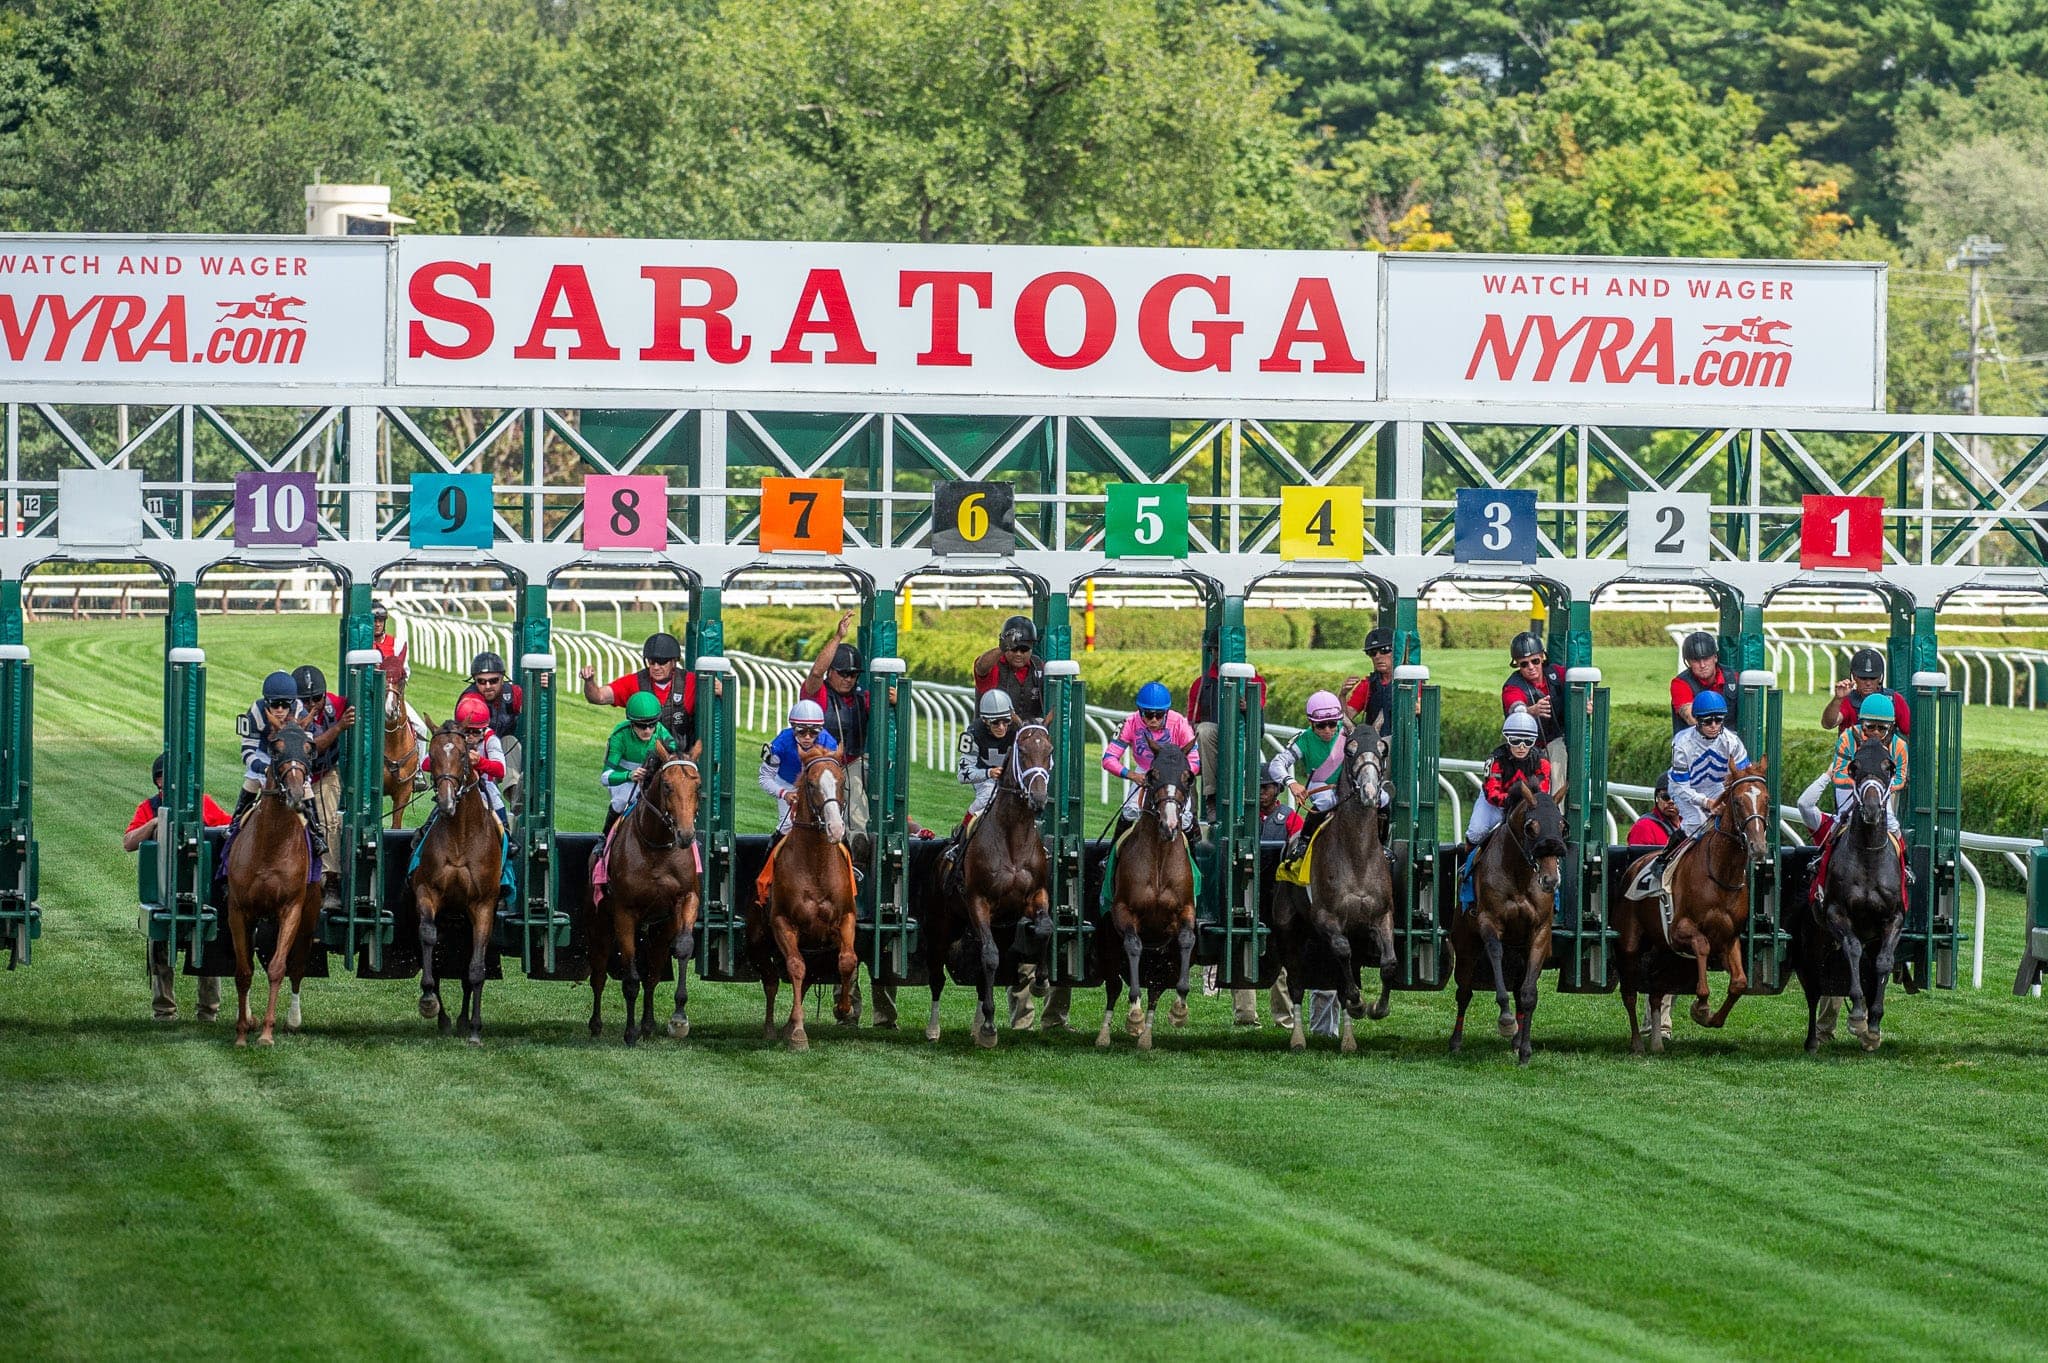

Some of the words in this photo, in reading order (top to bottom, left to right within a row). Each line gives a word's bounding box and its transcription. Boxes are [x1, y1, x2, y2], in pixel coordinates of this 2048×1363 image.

[0, 255, 99, 274] WATCH
[118, 256, 182, 275] AND
[200, 256, 307, 276] WAGER
[1483, 275, 1589, 296] WATCH
[1606, 278, 1670, 297] AND
[1688, 280, 1793, 300] WAGER
[0, 294, 307, 364] NYRA.com
[408, 260, 1366, 375] SARATOGA
[1465, 314, 1793, 388] NYRA.com
[25, 498, 39, 511] 12
[149, 500, 162, 514] 11
[249, 484, 305, 533] 10
[437, 486, 468, 533] 9
[610, 488, 640, 536] 8
[788, 491, 818, 539] 7
[957, 493, 989, 542] 6
[1135, 496, 1164, 545] 5
[1305, 499, 1336, 546] 4
[1482, 502, 1512, 551] 3
[1655, 506, 1685, 554] 2
[1830, 507, 1851, 557] 1
[237, 716, 250, 736] 10
[960, 733, 971, 753] 6
